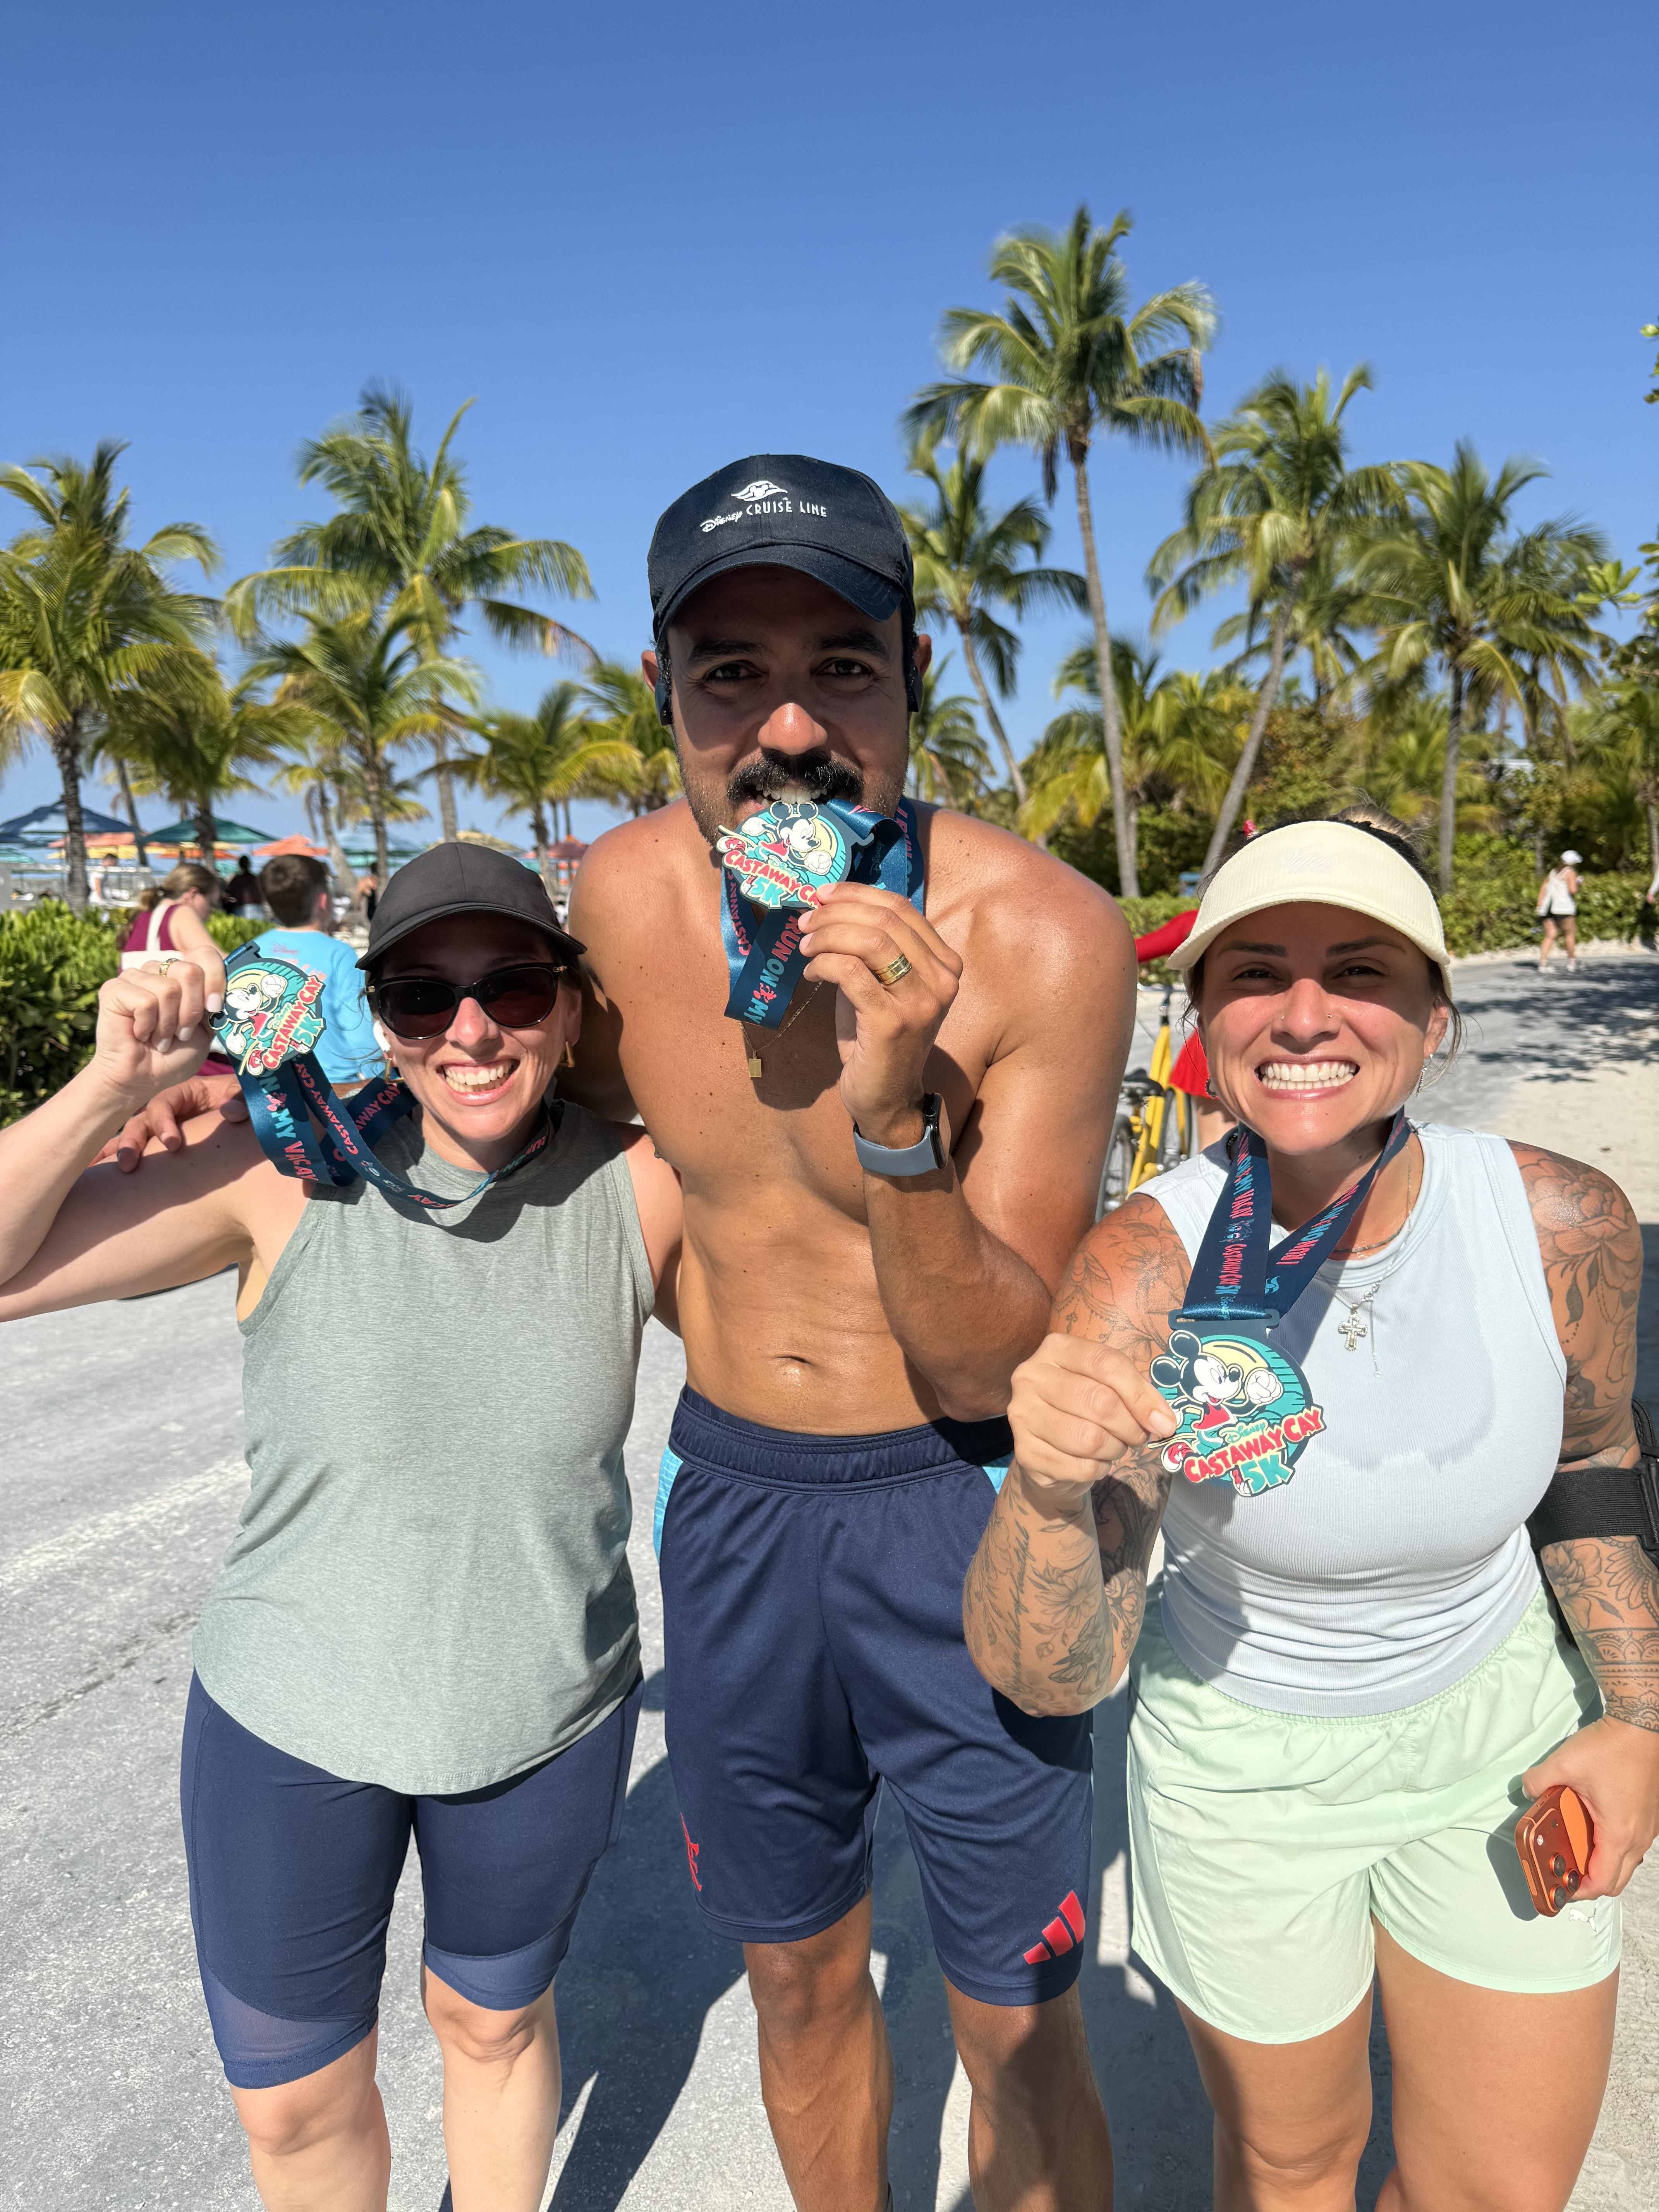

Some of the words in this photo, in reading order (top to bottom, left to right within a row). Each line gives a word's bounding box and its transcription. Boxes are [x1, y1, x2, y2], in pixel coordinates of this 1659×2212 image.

[746, 501, 792, 515] CRUISE
[800, 501, 827, 517] LINE
[725, 850, 801, 892] CASTAWAY
[800, 885, 822, 908] CA
[750, 876, 785, 905] 5K
[730, 882, 752, 956] CASTAWAY
[771, 915, 802, 962] RUN
[759, 958, 785, 988] ON
[263, 1001, 309, 1068] CASTAWAY
[299, 977, 321, 1002] CAY
[744, 997, 769, 1024] MY
[292, 1015, 322, 1046] 5K
[295, 1063, 315, 1088] CAY
[376, 1083, 401, 1105] CAY
[311, 1089, 358, 1155] CASTAWAY
[271, 1108, 297, 1138] MY
[284, 1140, 319, 1181] VACAY
[1233, 1174, 1253, 1195] MY
[1230, 1188, 1254, 1219] VACAY
[1281, 1239, 1319, 1261] RUN
[1301, 1222, 1332, 1242] ON
[1320, 1202, 1349, 1221] MY
[1221, 1243, 1247, 1274] CASTAWAY
[1214, 1285, 1241, 1295] 5K
[1219, 1274, 1243, 1285] CAY
[1184, 1428, 1283, 1482] CASTAWAY
[1283, 1409, 1322, 1442] CAY
[1240, 1454, 1291, 1493] 5K
